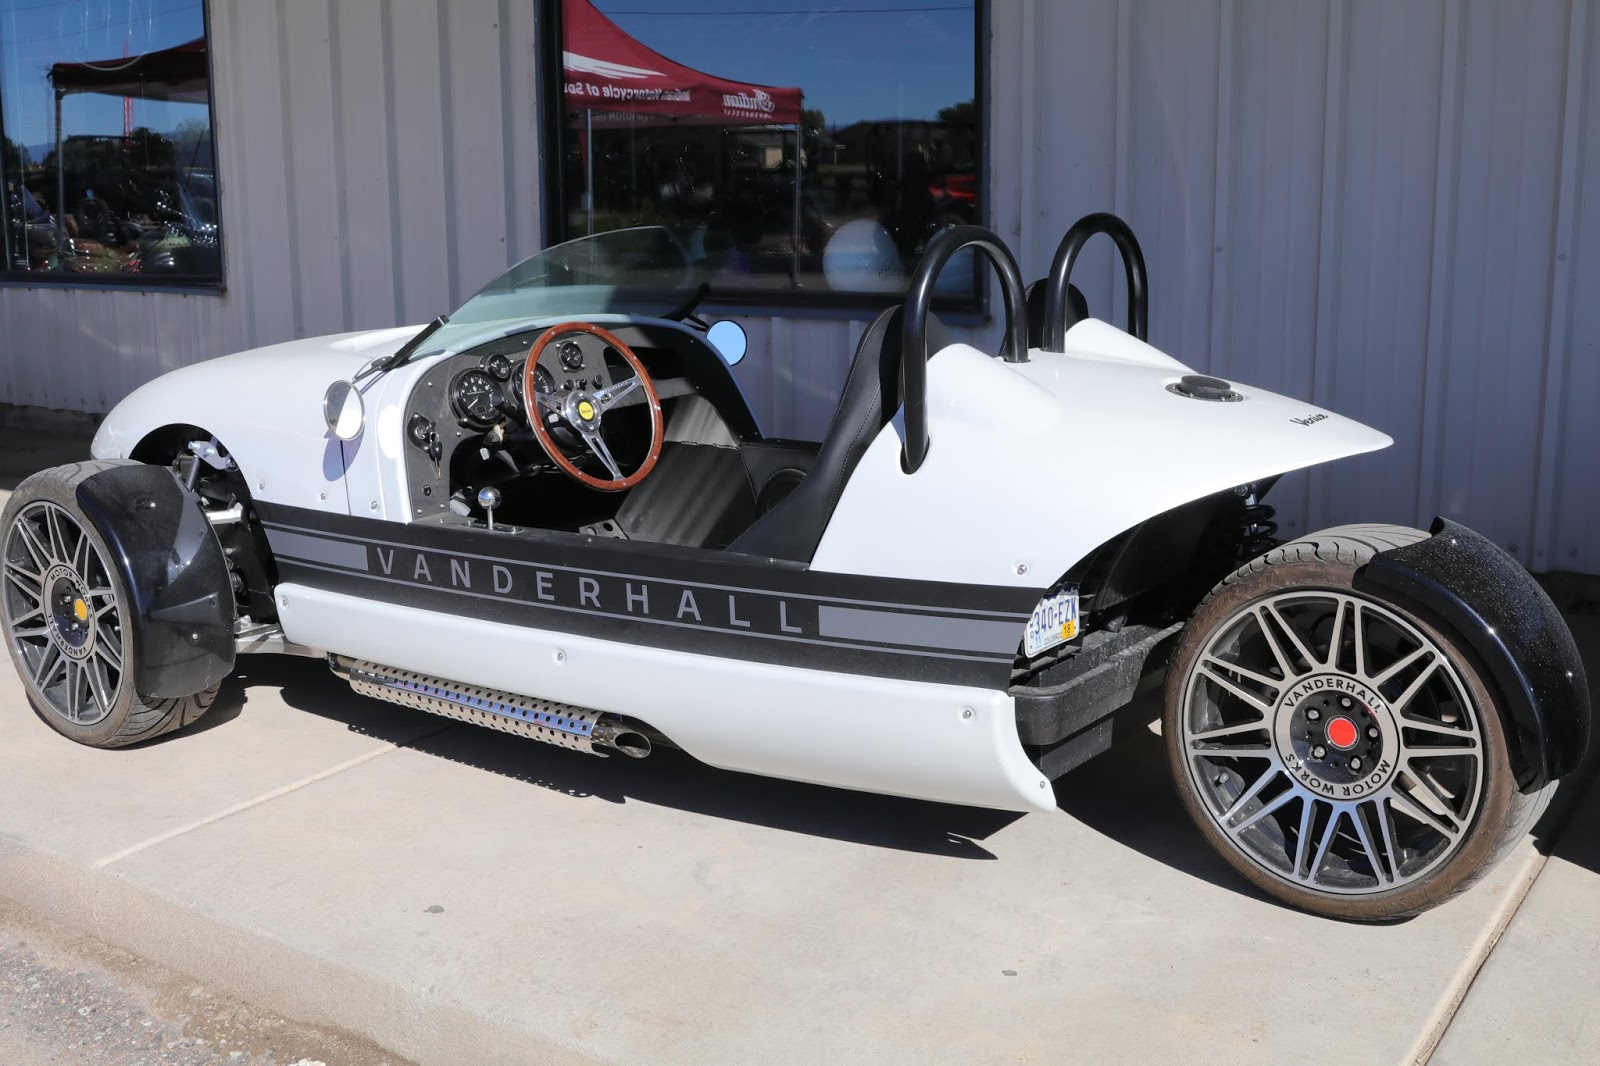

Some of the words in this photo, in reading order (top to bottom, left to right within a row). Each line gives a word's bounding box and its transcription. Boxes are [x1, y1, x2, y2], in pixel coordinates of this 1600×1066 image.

[50, 567, 73, 582] MOTOR
[75, 577, 94, 619] WORKS
[376, 547, 804, 634] VANDERHALL
[47, 613, 88, 656] VANDERHALL
[1033, 596, 1077, 635] 340-EZK
[1063, 623, 1071, 635] 18
[1284, 678, 1383, 714] VANDERHALL
[1285, 754, 1335, 795] WORKS
[1342, 759, 1391, 796] MOTOR
